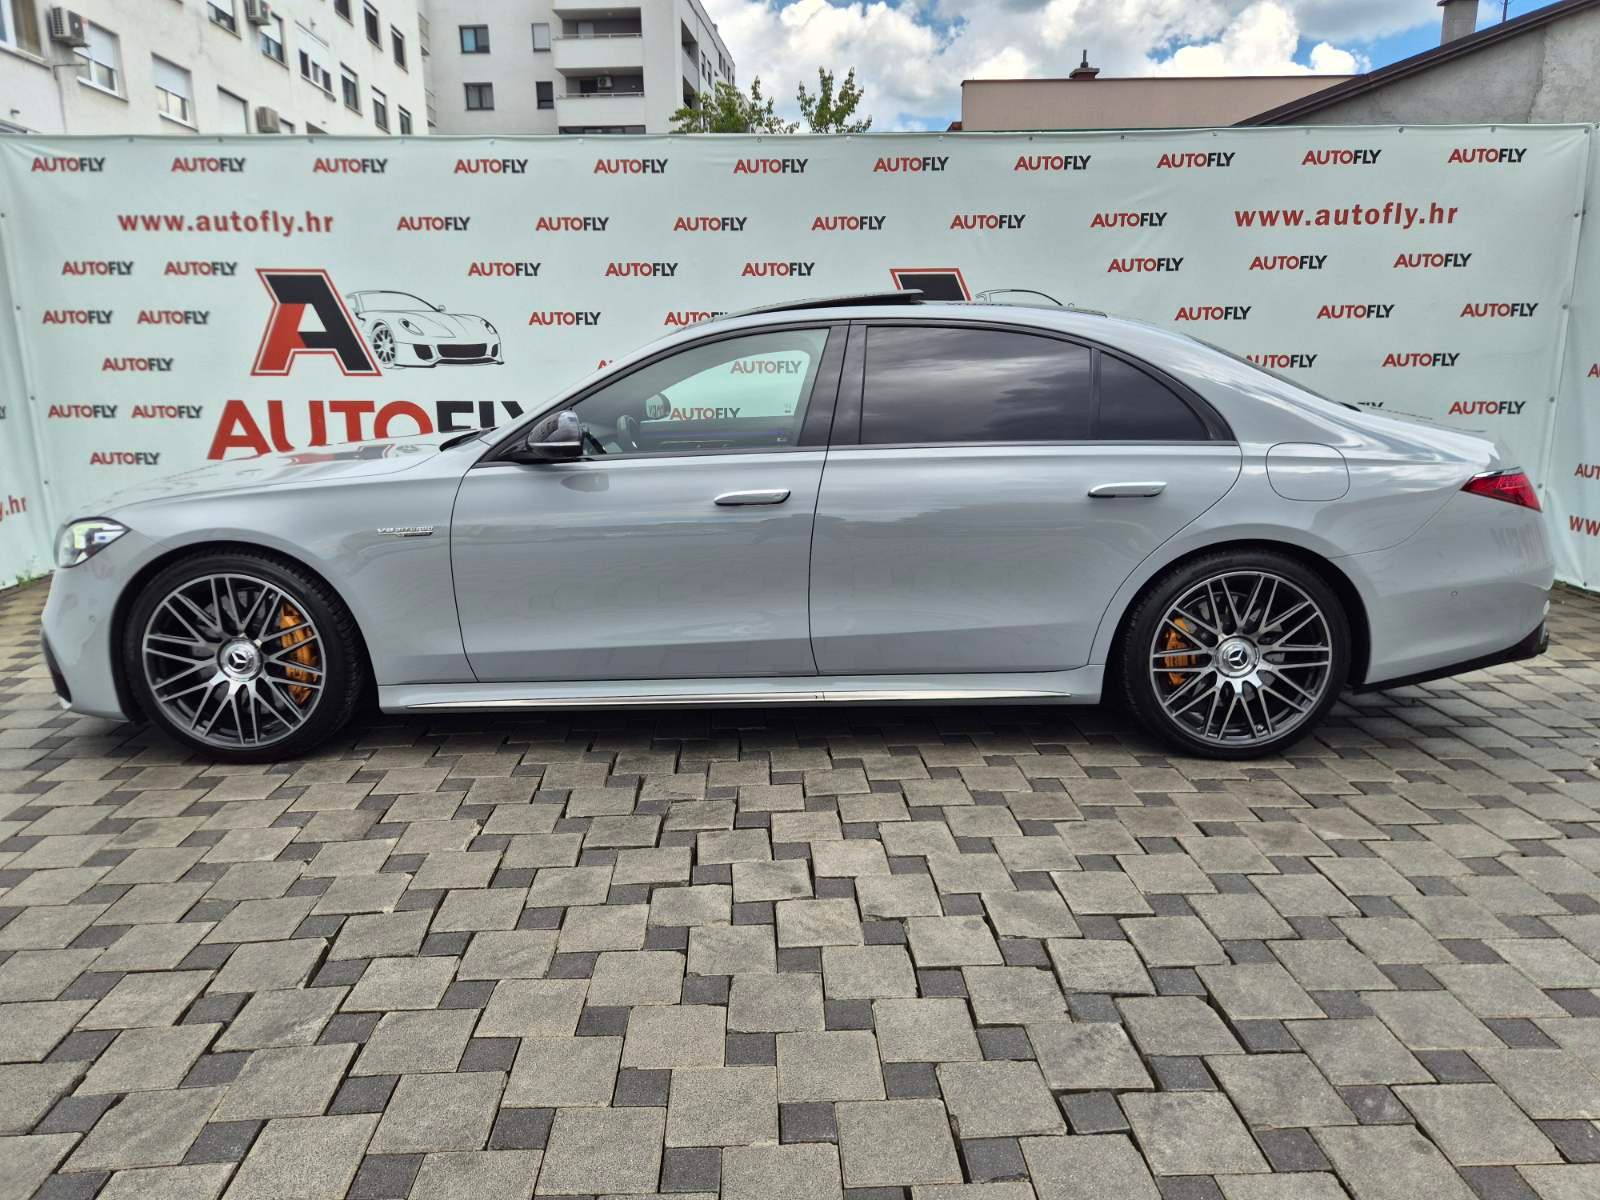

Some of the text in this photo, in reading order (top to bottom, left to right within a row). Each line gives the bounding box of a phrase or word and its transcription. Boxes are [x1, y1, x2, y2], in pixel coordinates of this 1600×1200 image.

[1014, 155, 1091, 171] AUTOFLY
[1157, 152, 1235, 168] AUTOFLY
[1302, 150, 1382, 165] AUTOFLY
[1448, 148, 1527, 163] AUTOFLY
[32, 157, 105, 172] AUTOFLY
[171, 157, 245, 172] AUTOFLY
[313, 157, 388, 173] AUTOFLY
[454, 159, 528, 173] AUTOFLY
[594, 159, 668, 173] AUTOFLY
[734, 159, 808, 174] AUTOFLY
[873, 157, 949, 173] AUTOFLY
[118, 209, 333, 237] www.autofly.hr
[950, 213, 1026, 229] AUTOFLY
[1090, 212, 1167, 228] AUTOFLY
[1235, 201, 1458, 230] www.autofly.hr
[397, 216, 470, 231] AUTOFLY
[536, 217, 609, 231] AUTOFLY
[674, 217, 747, 231] AUTOFLY
[812, 216, 886, 231] AUTOFLY
[62, 261, 133, 275] AUTOFLY
[1107, 257, 1183, 272] AUTOFLY
[1250, 255, 1327, 270] AUTOFLY
[1394, 253, 1472, 268] AUTOFLY
[165, 262, 237, 276] AUTOFLY
[468, 262, 541, 276] AUTOFLY
[605, 262, 678, 277] AUTOFLY
[742, 262, 815, 276] AUTOFLY
[43, 310, 113, 324] AUTOFLY
[138, 310, 210, 324] AUTOFLY
[1175, 306, 1251, 321] AUTOFLY
[1317, 304, 1395, 319] AUTOFLY
[1460, 303, 1538, 317] AUTOFLY
[528, 311, 601, 326] AUTOFLY
[102, 358, 173, 371] AUTOFLY
[730, 361, 802, 374] AUTOFLY
[1382, 353, 1460, 367] AUTOFLY
[48, 405, 117, 418] AUTOFLY
[132, 405, 203, 419] AUTOFLY
[1449, 401, 1526, 415] AUTOFLY
[90, 452, 160, 465] AUTOFLY
